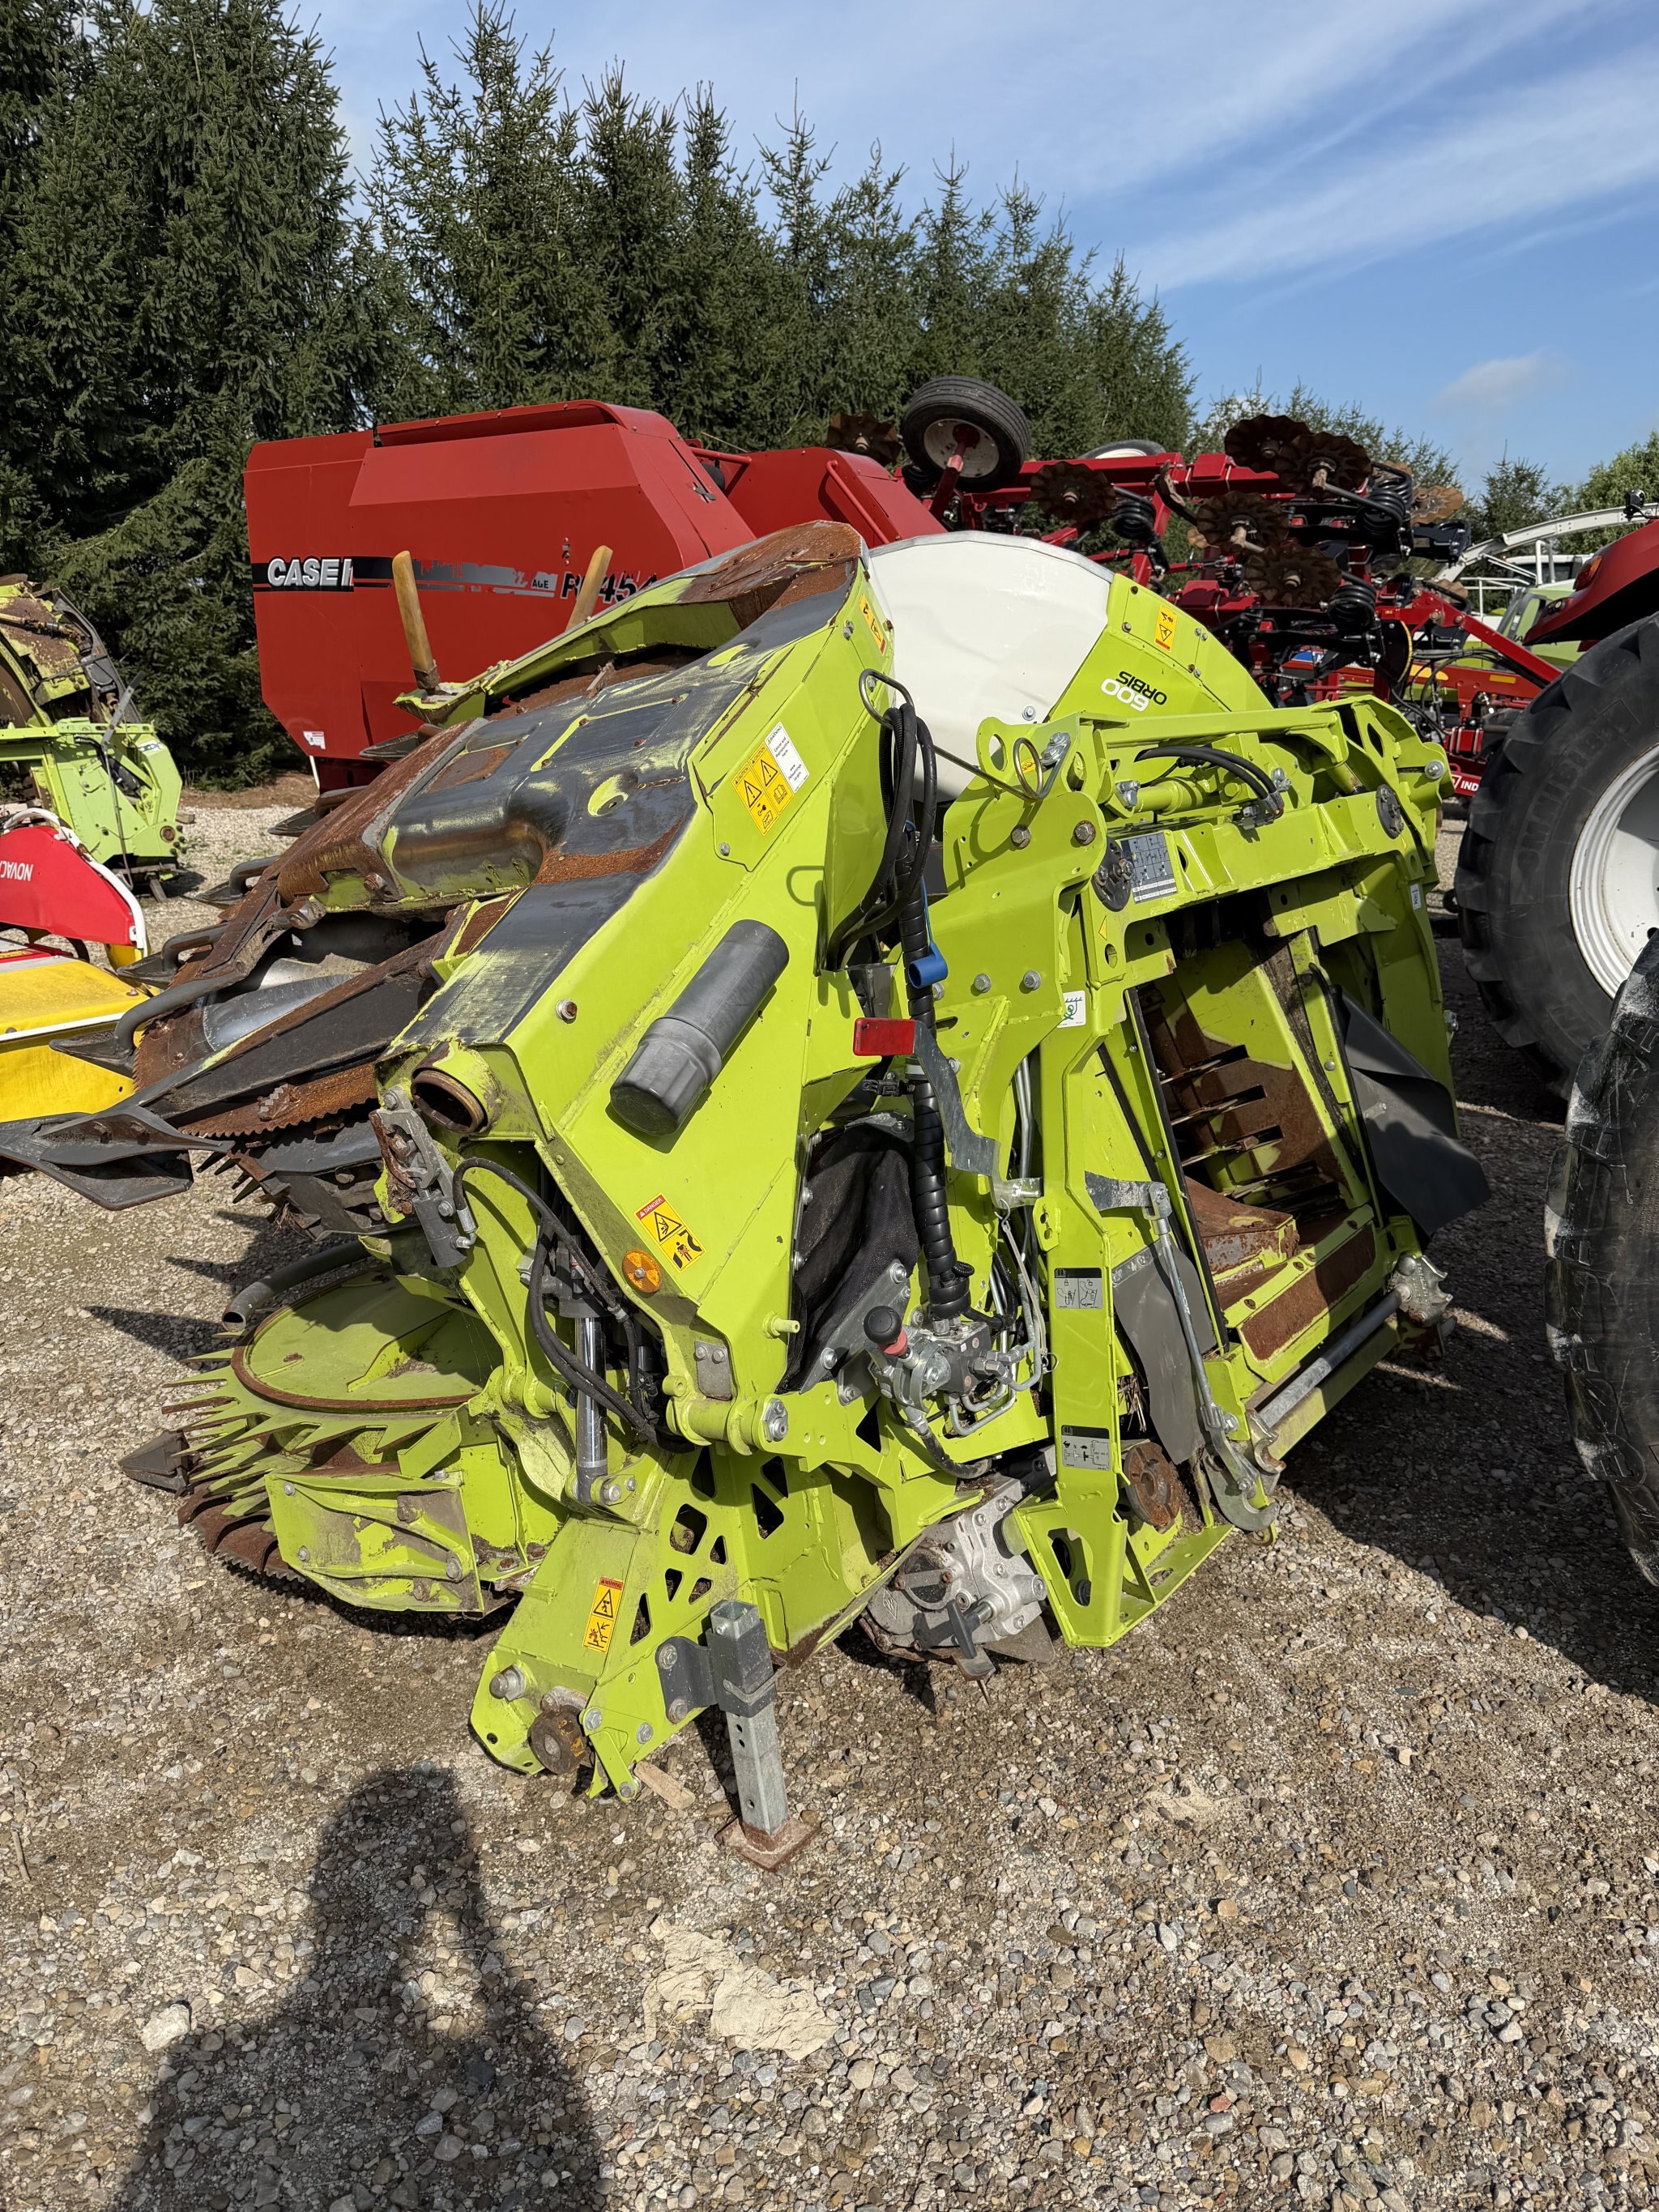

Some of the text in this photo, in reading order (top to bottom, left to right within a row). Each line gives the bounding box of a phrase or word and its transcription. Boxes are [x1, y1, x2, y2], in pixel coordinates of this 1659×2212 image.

[1101, 678, 1149, 712] 600
[1115, 671, 1167, 705] ORBIS
[0, 860, 34, 881] NOVAC
[644, 1197, 663, 1213] DANGER
[604, 1579, 621, 1588] WARNING
